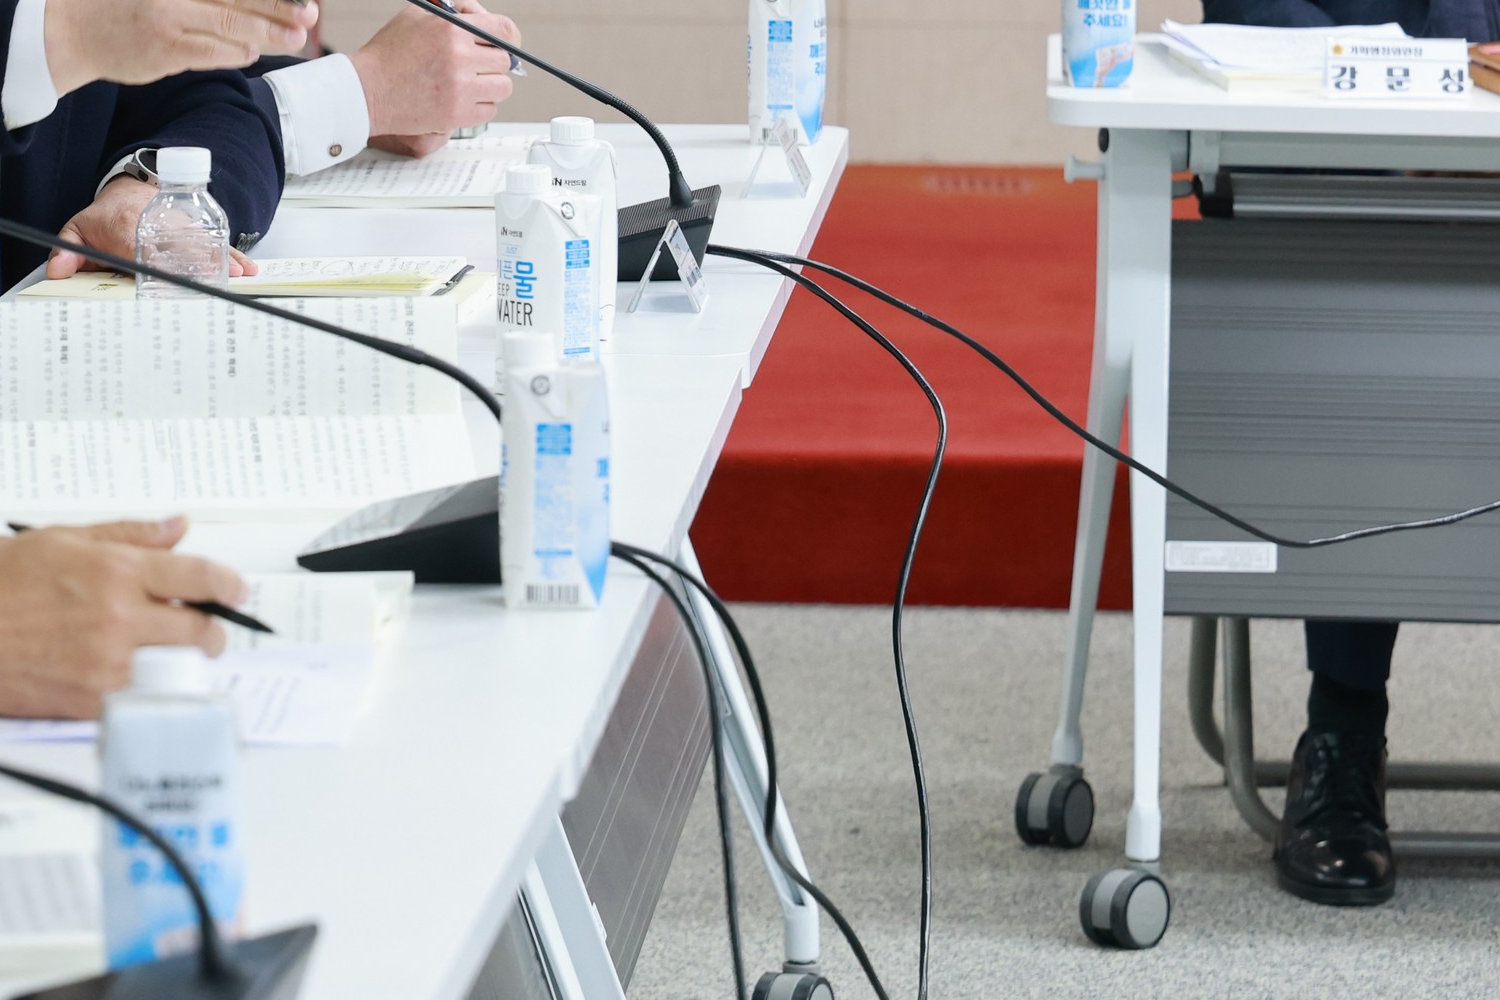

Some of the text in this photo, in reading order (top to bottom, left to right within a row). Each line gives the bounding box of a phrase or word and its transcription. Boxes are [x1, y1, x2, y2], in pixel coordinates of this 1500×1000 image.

[1331, 65, 1464, 94] 강 문 성
[564, 179, 587, 187] 자연드림
